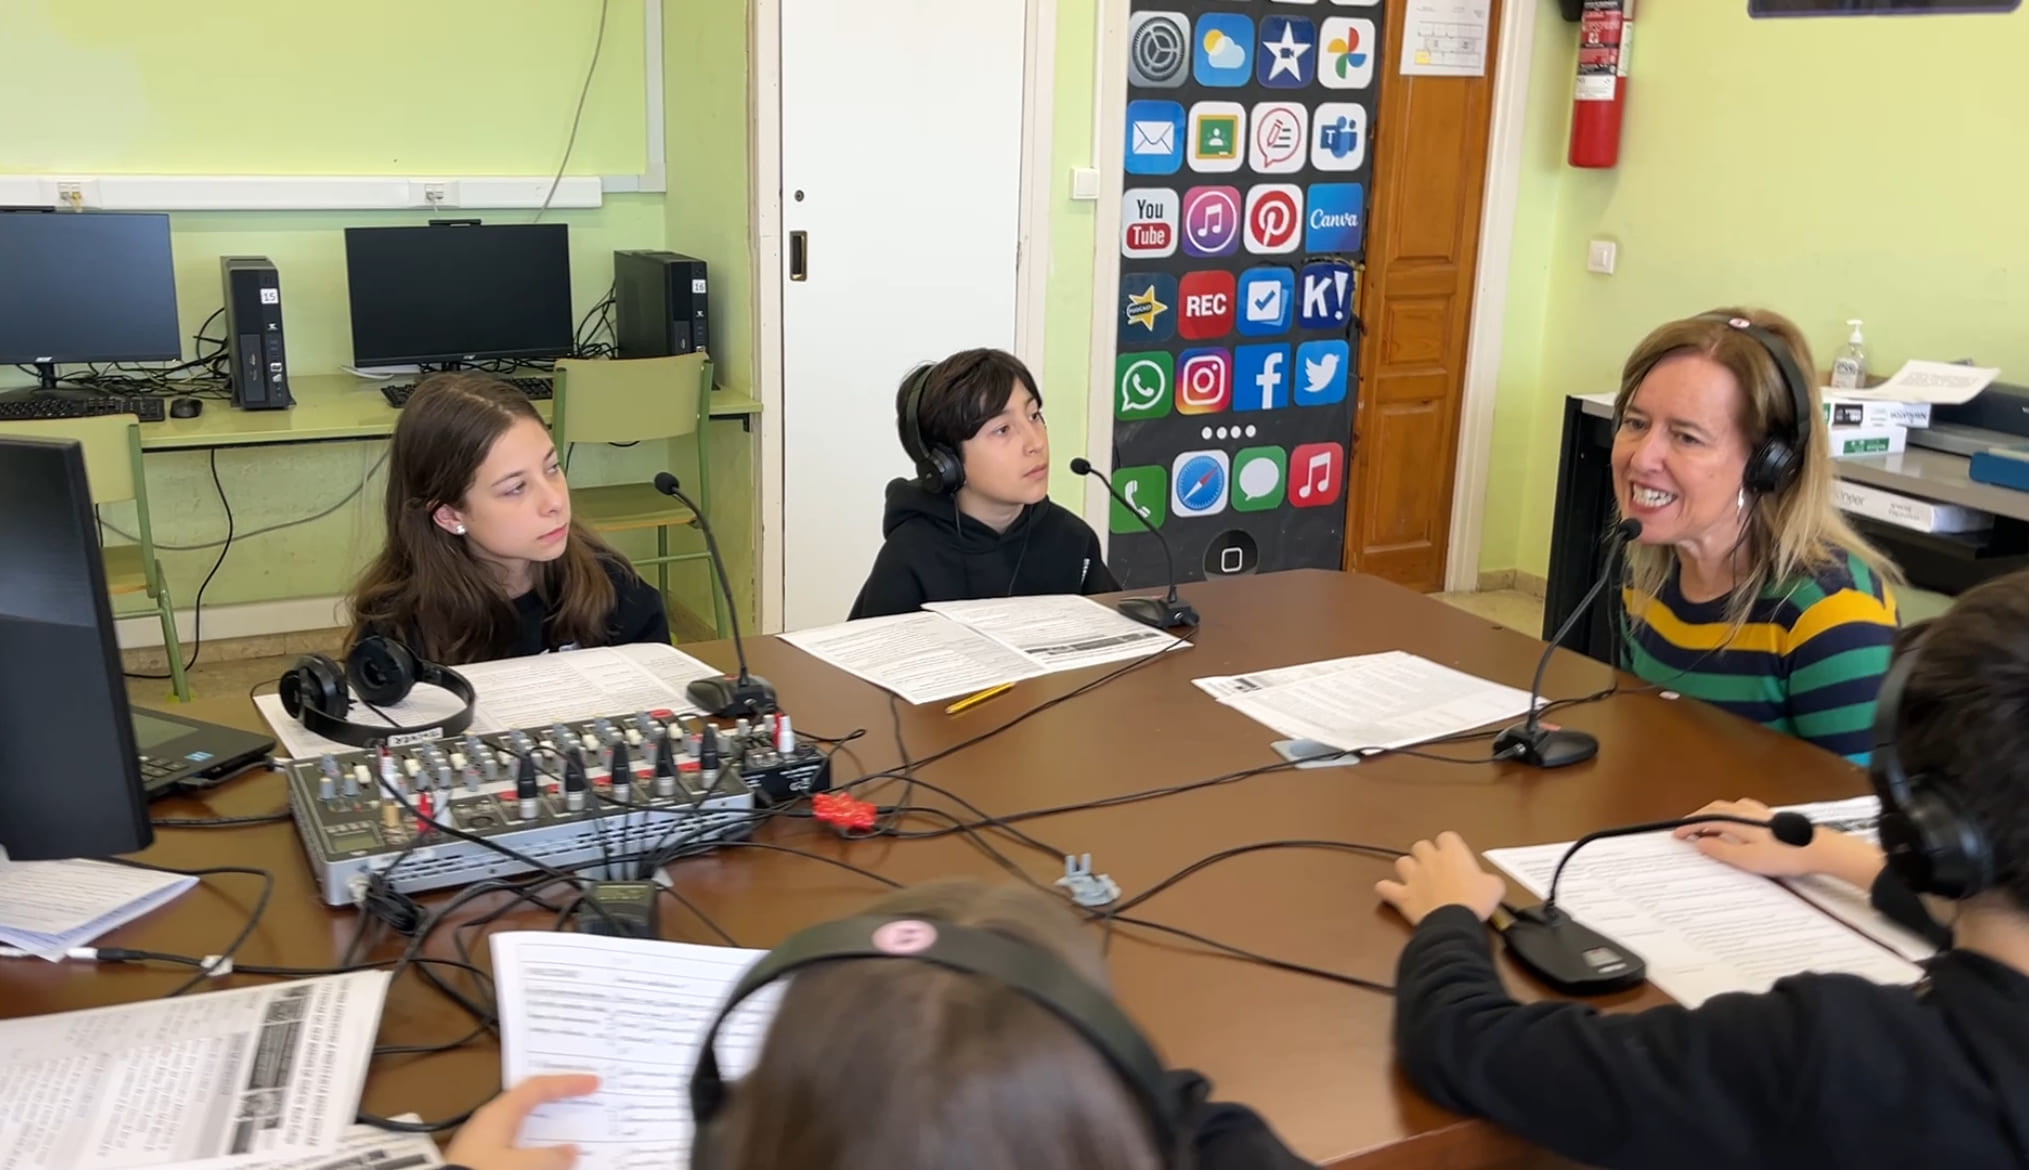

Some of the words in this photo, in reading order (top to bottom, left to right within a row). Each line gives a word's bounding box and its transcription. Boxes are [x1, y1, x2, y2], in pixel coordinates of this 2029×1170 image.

[1137, 199, 1164, 220] You
[1310, 208, 1358, 230] Canva
[1133, 226, 1165, 245] Tube
[263, 291, 276, 302] 15
[1186, 293, 1227, 317] REC
[1302, 270, 1349, 320] K!
